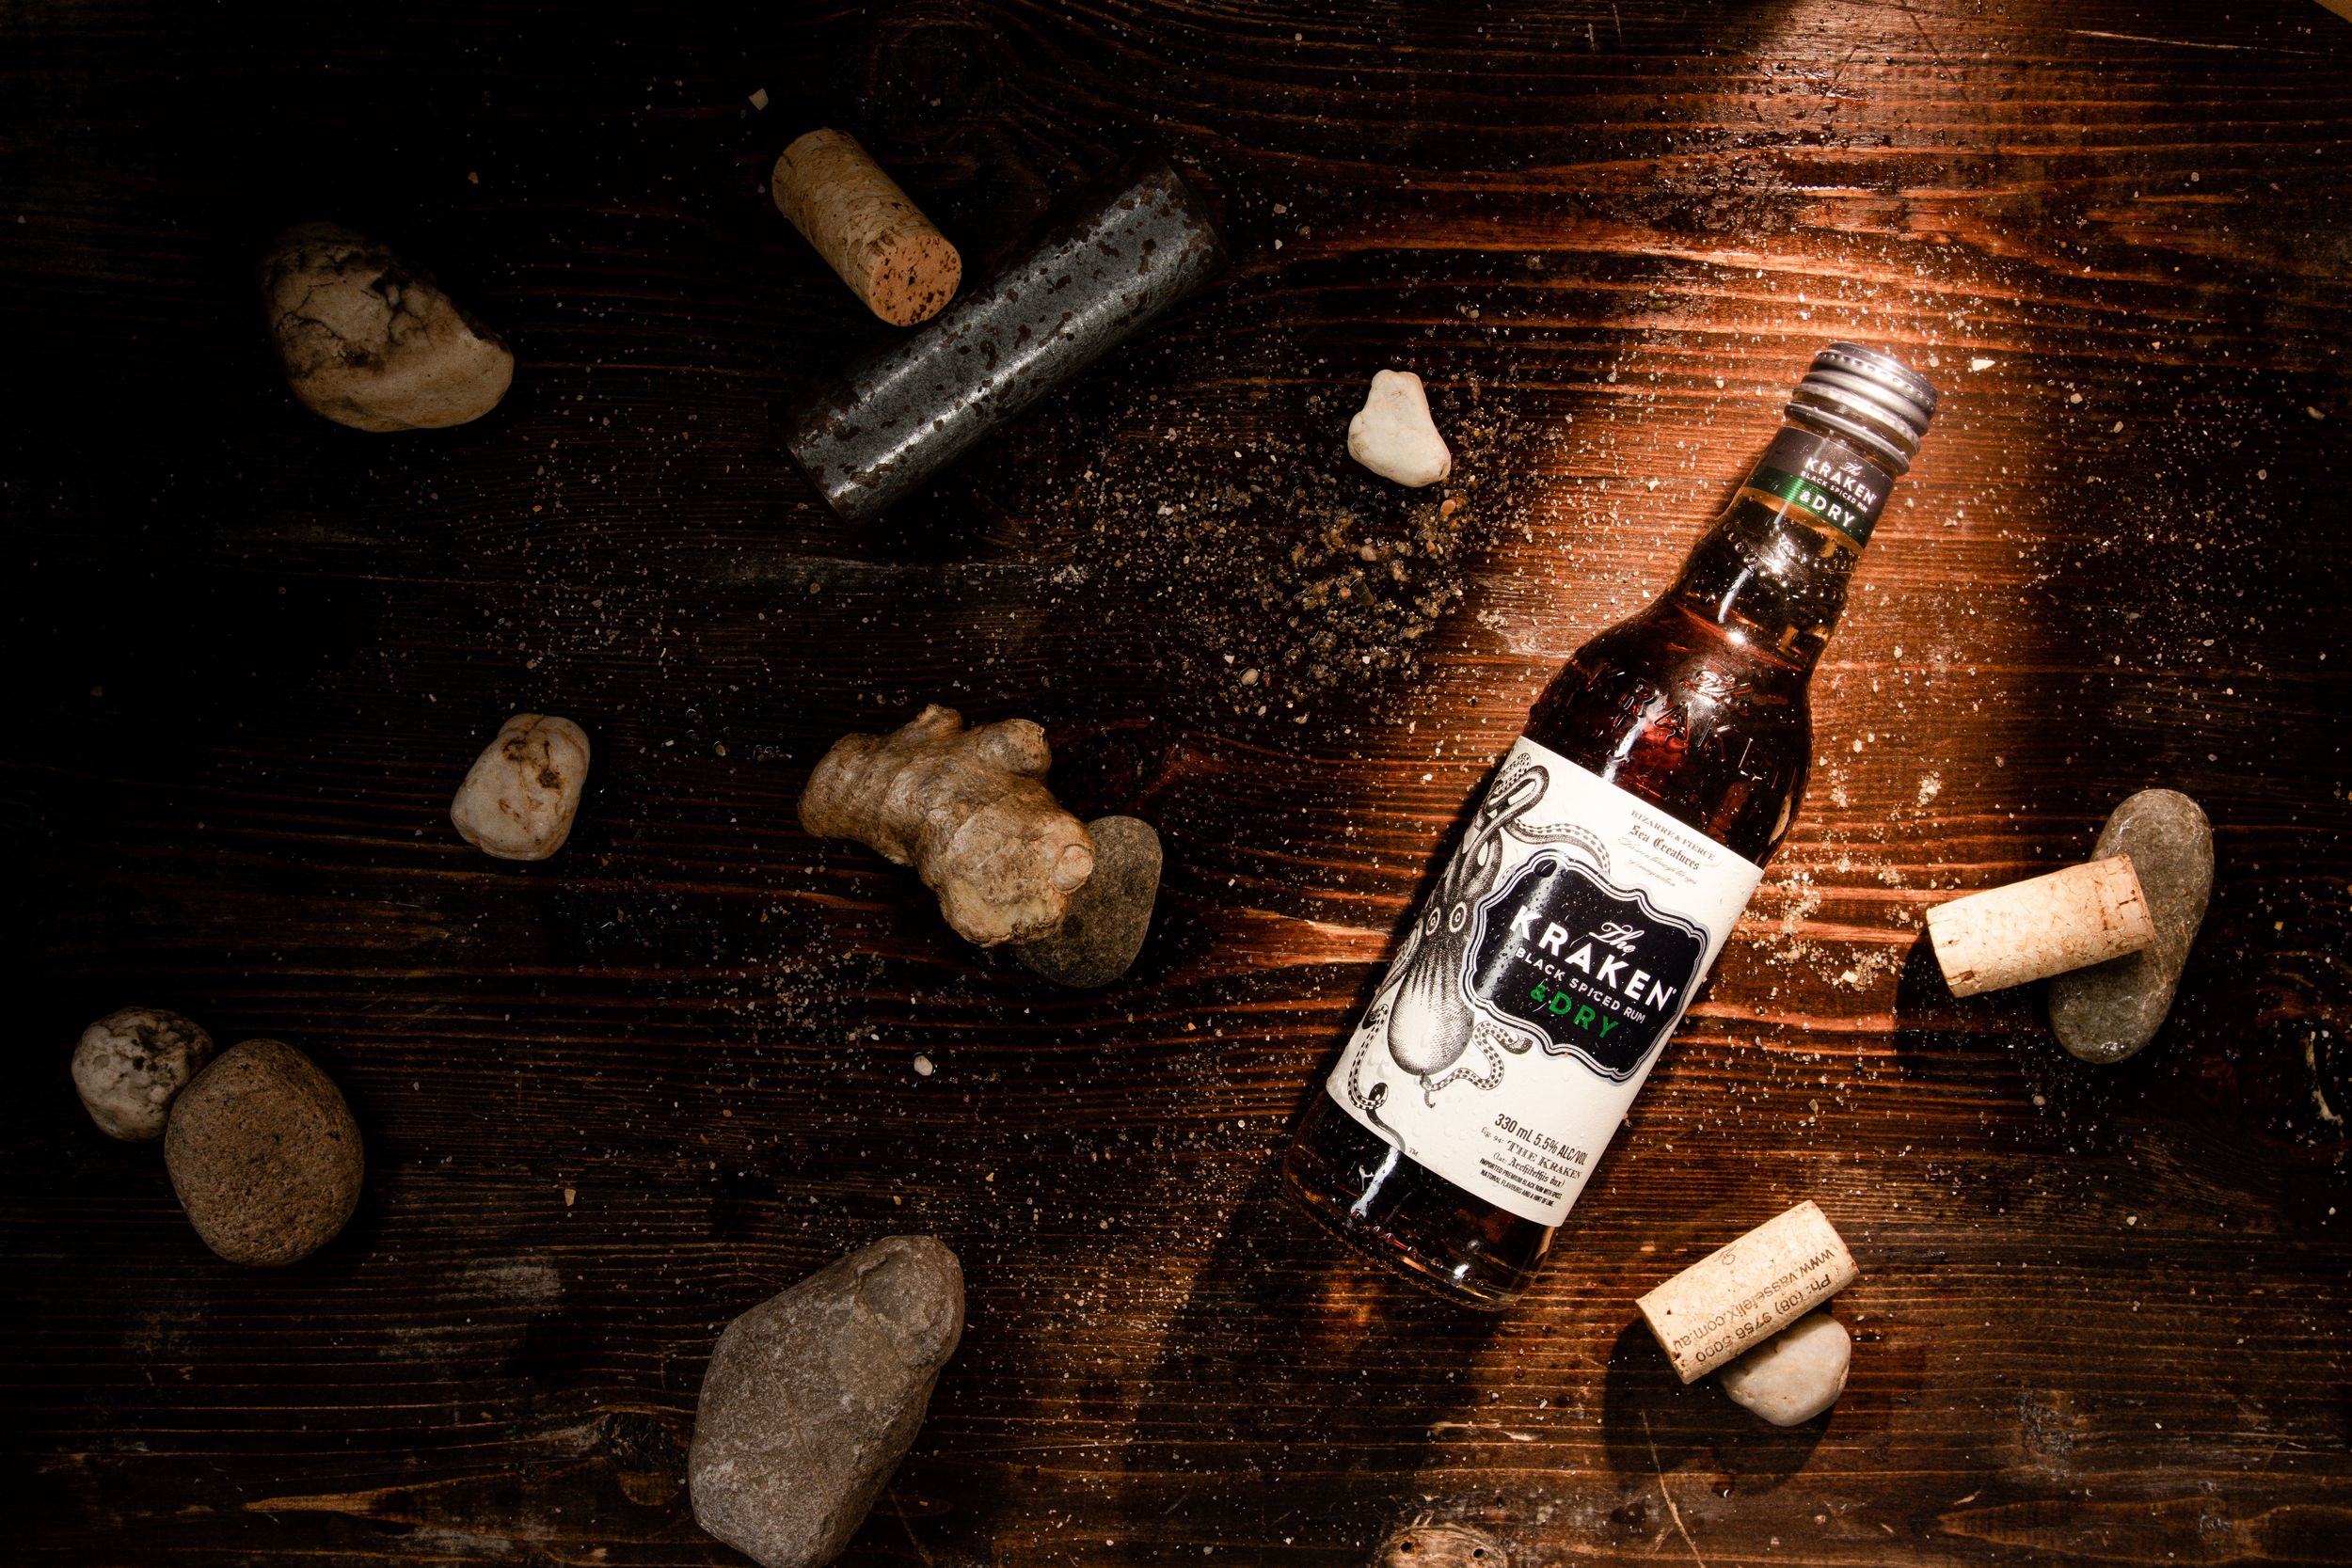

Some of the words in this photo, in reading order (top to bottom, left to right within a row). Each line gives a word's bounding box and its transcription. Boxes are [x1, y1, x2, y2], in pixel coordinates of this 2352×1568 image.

[1800, 471, 1827, 487] BLACK
[1830, 485, 1857, 504] SPICED
[1857, 501, 1868, 513] RUM
[1804, 457, 1876, 505] KRAKEN
[1629, 825, 1650, 843] Sea
[1653, 837, 1700, 870] Creatures
[1630, 810, 1674, 838] BIZARRE
[1682, 837, 1716, 861] FIERCE
[1589, 922, 1645, 953] The
[1509, 905, 1675, 1012] KRAKEN
[1515, 946, 1566, 982] BLACK
[1568, 977, 1621, 1011] SPICED
[1623, 1006, 1646, 1024] RUM
[1494, 1113, 1518, 1133] 330
[1516, 1127, 1534, 1143] mL
[1534, 1132, 1559, 1154] 5.5%
[1557, 1145, 1588, 1166] ALC/VOL
[1506, 1140, 1538, 1163] THE
[1537, 1156, 1582, 1180] KRAKEN
[1479, 1157, 1502, 1174] IMPORTED
[1502, 1169, 1523, 1183] PREMIUM
[1521, 1179, 1534, 1189] BLACK
[1480, 1169, 1501, 1184] NATURAL
[1501, 1180, 1522, 1194] FLAVOURS
[1673, 1247, 1835, 1352] www.vassefelix.com.au
[1774, 1292, 1804, 1315] (08)
[1807, 1274, 1832, 1294] Ph:
[1735, 1312, 1772, 1339] 9756
[1695, 1335, 1733, 1363] 5000
